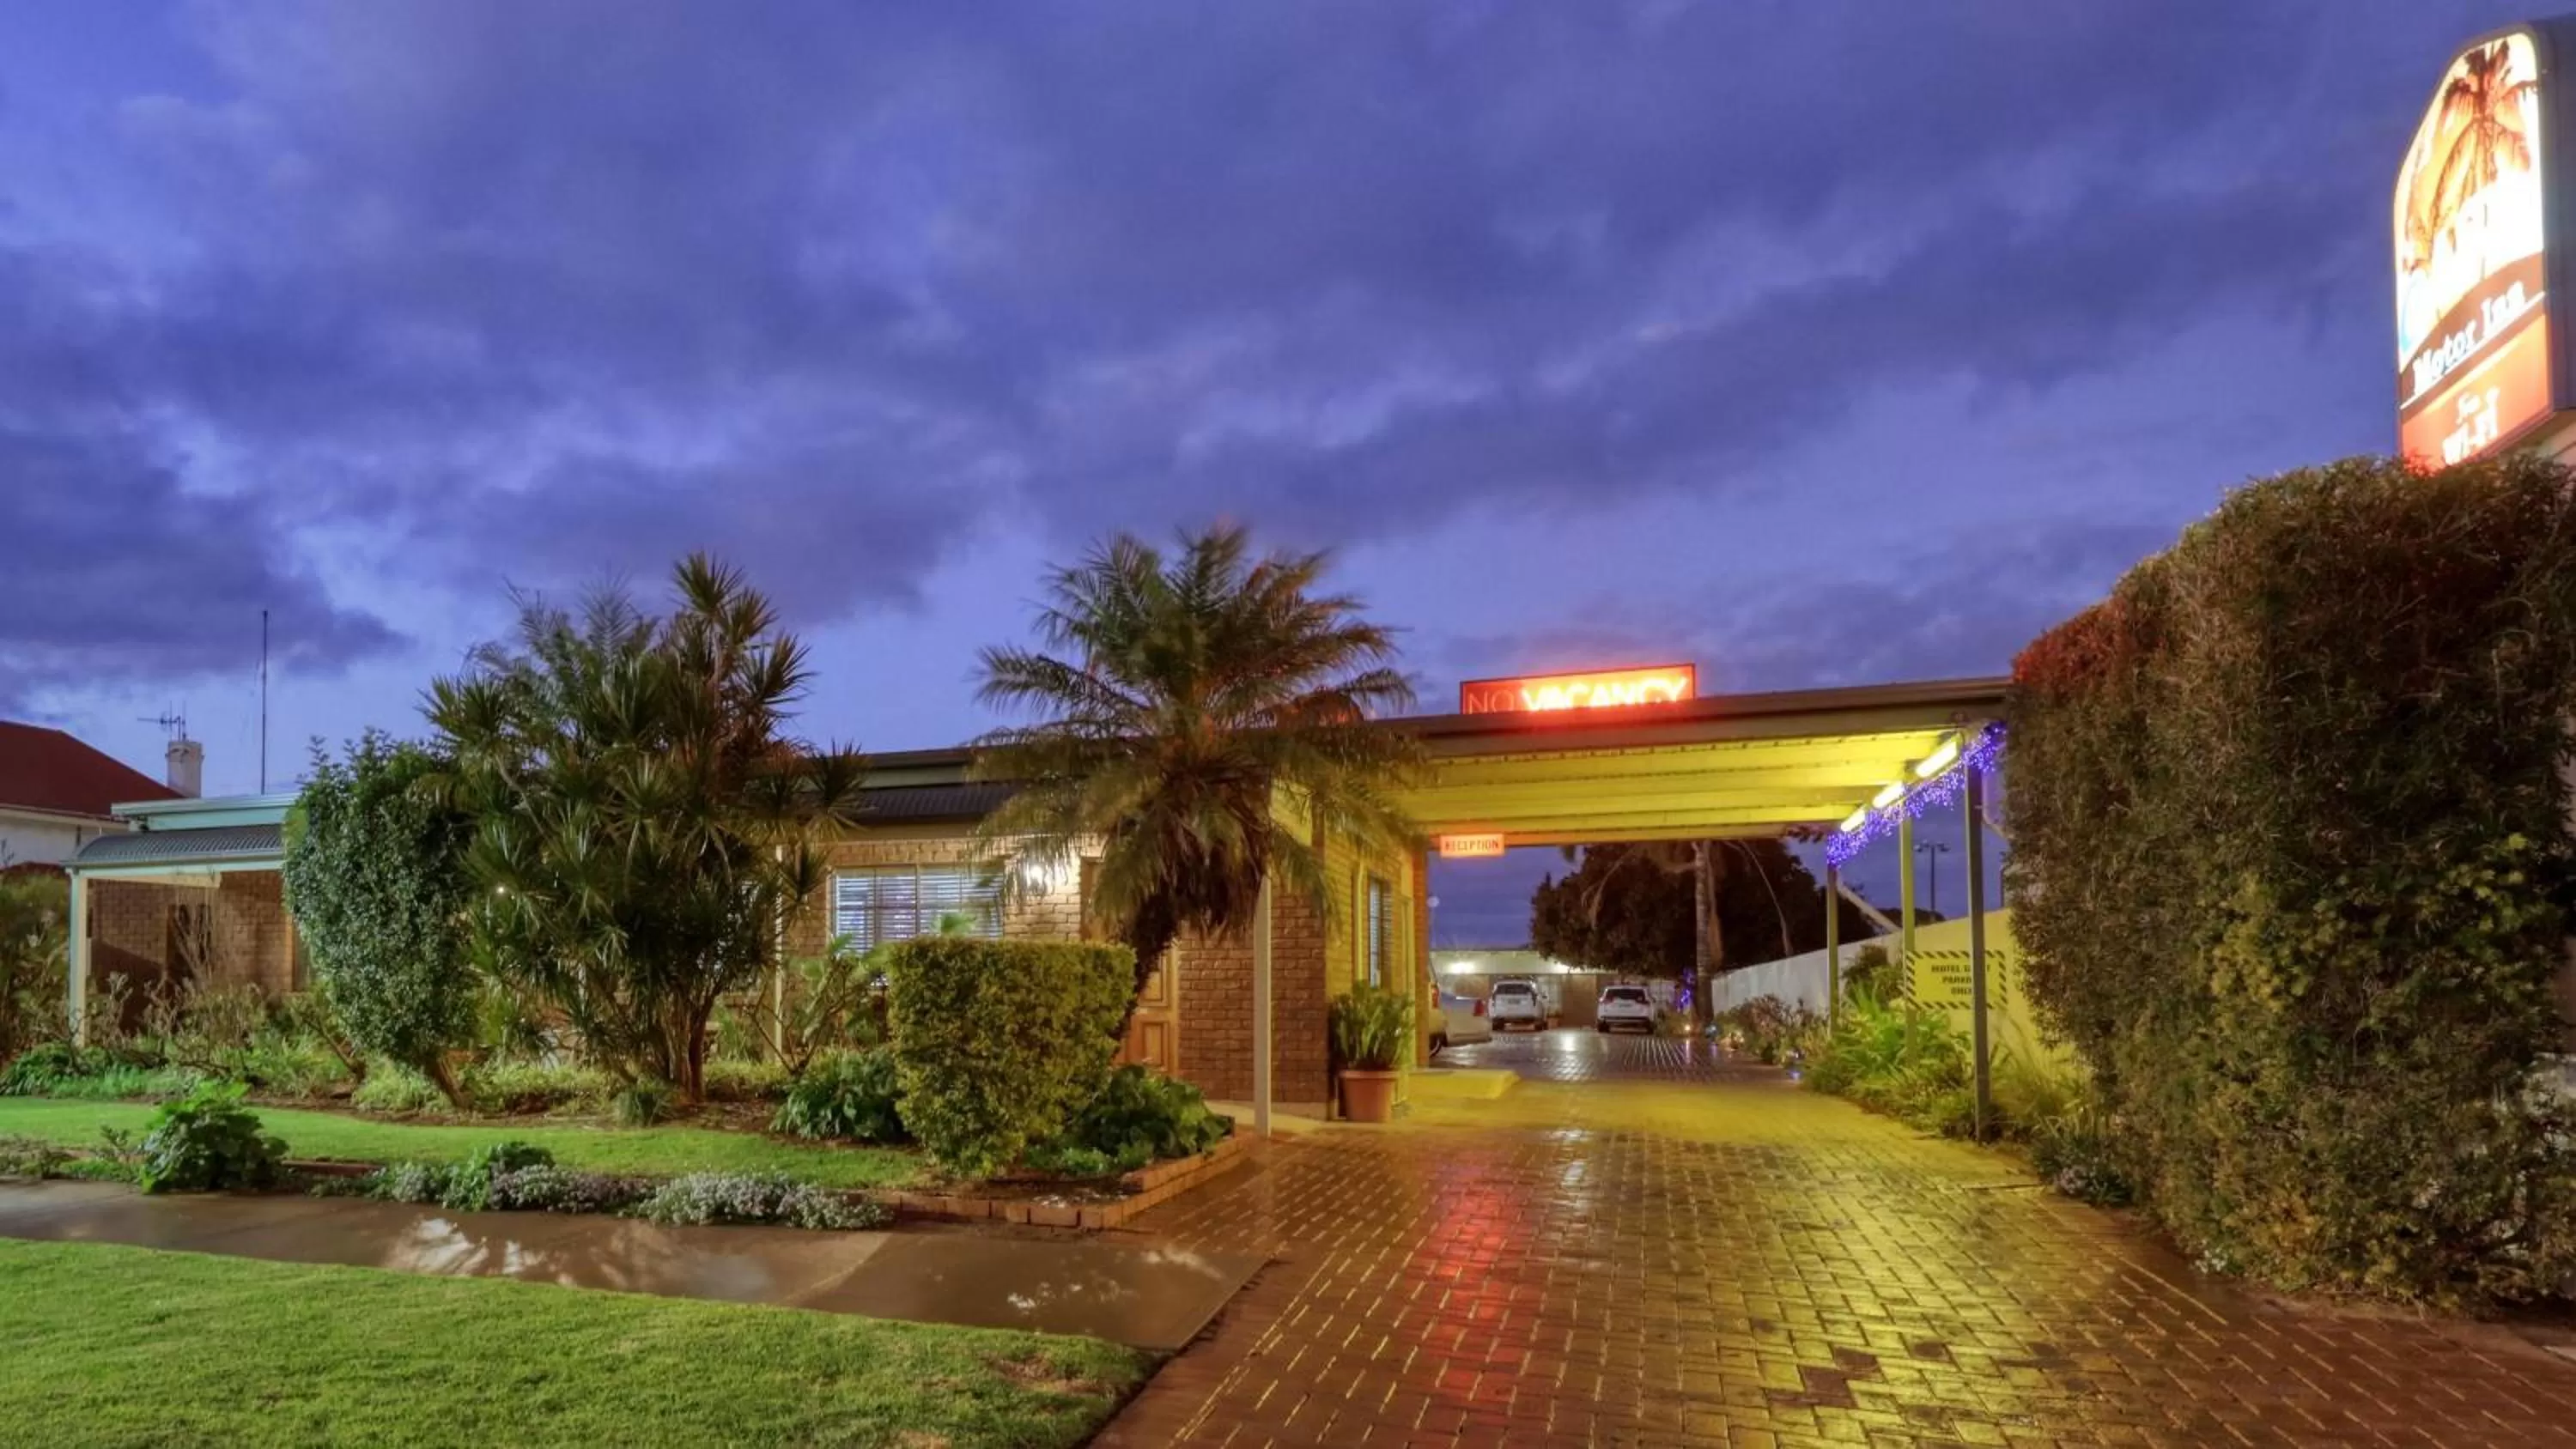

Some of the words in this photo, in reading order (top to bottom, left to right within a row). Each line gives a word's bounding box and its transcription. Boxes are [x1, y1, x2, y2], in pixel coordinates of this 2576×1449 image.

[2413, 320, 2477, 396] Motor
[2481, 281, 2524, 336] Inn
[1468, 689, 1515, 713] NO
[1521, 676, 1688, 711] VACANCY
[1444, 839, 1499, 852] RECEPTION
[1931, 964, 1960, 973] MOTEL
[1942, 975, 1972, 984] PARKI
